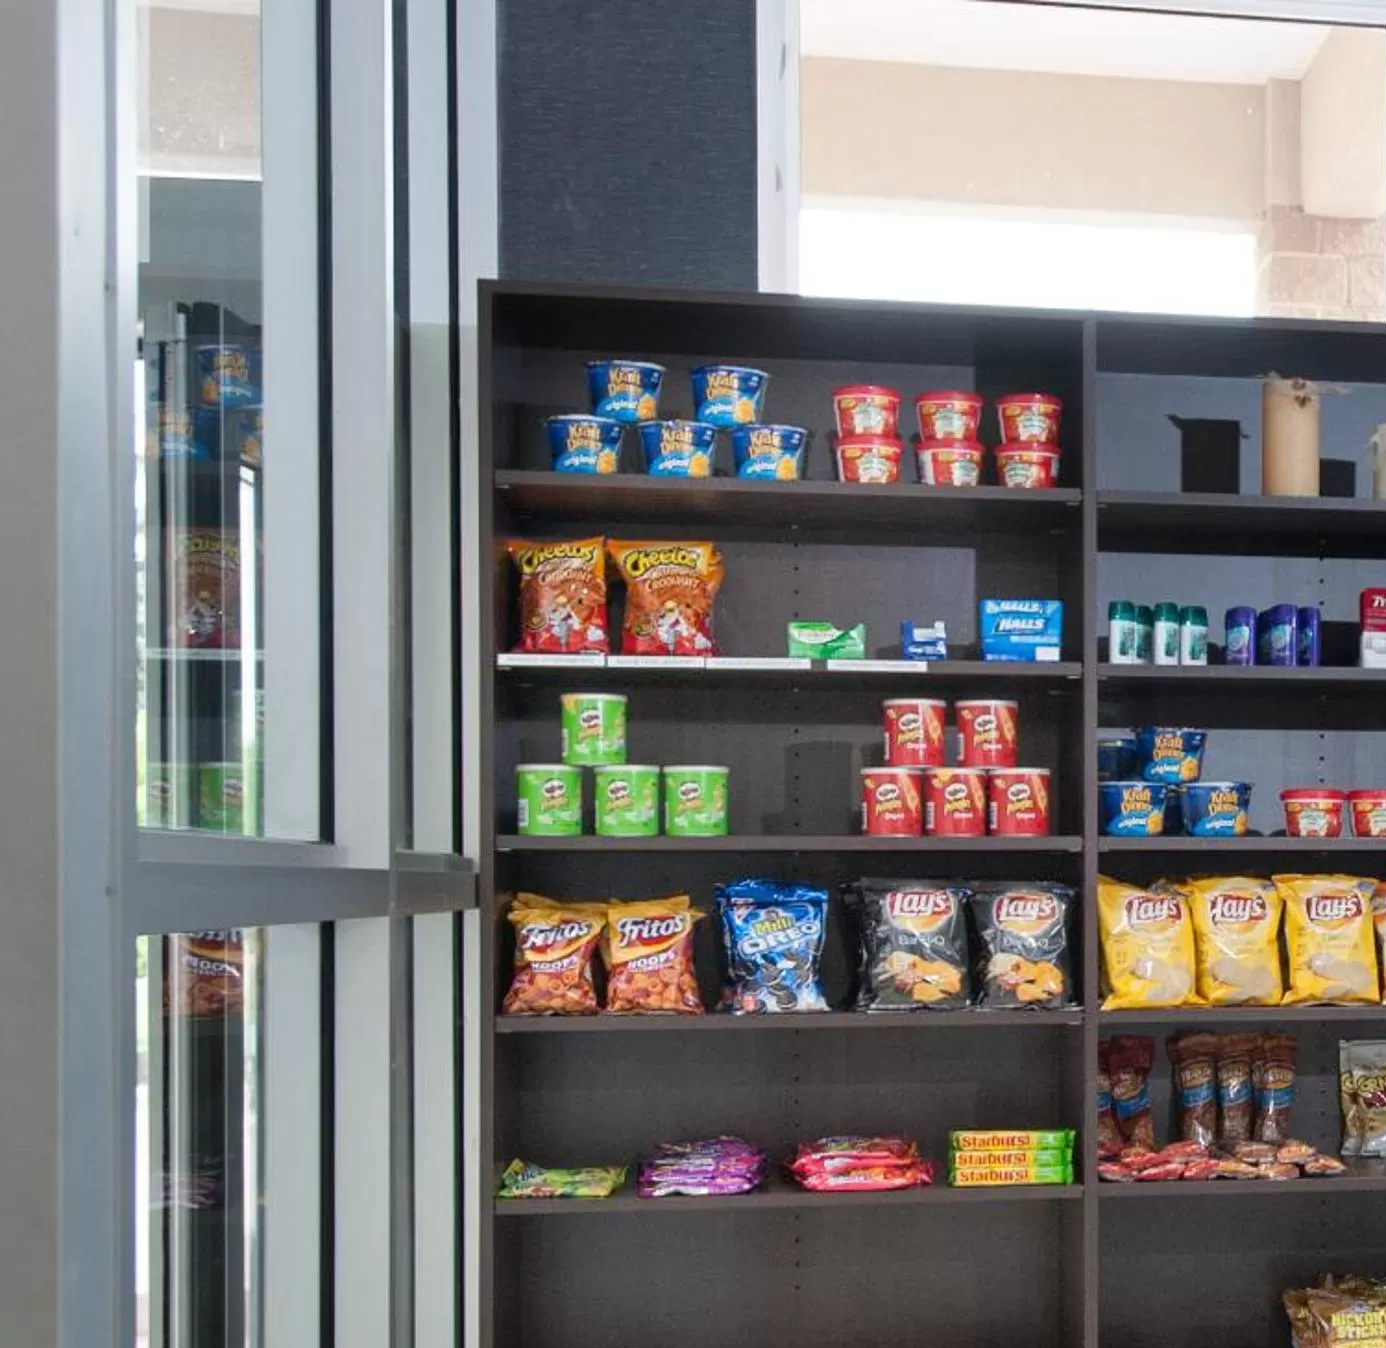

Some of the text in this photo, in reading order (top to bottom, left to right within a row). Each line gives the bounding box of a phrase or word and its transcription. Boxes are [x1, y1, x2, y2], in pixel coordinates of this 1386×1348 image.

[999, 617, 1045, 631] HALLS
[616, 914, 686, 948] Fritos
[738, 921, 820, 955] OREO
[627, 950, 677, 968] HOOPS
[962, 1135, 1031, 1148] Starburst
[958, 1151, 1027, 1165] Starburst
[959, 1168, 1029, 1182] Starburst
